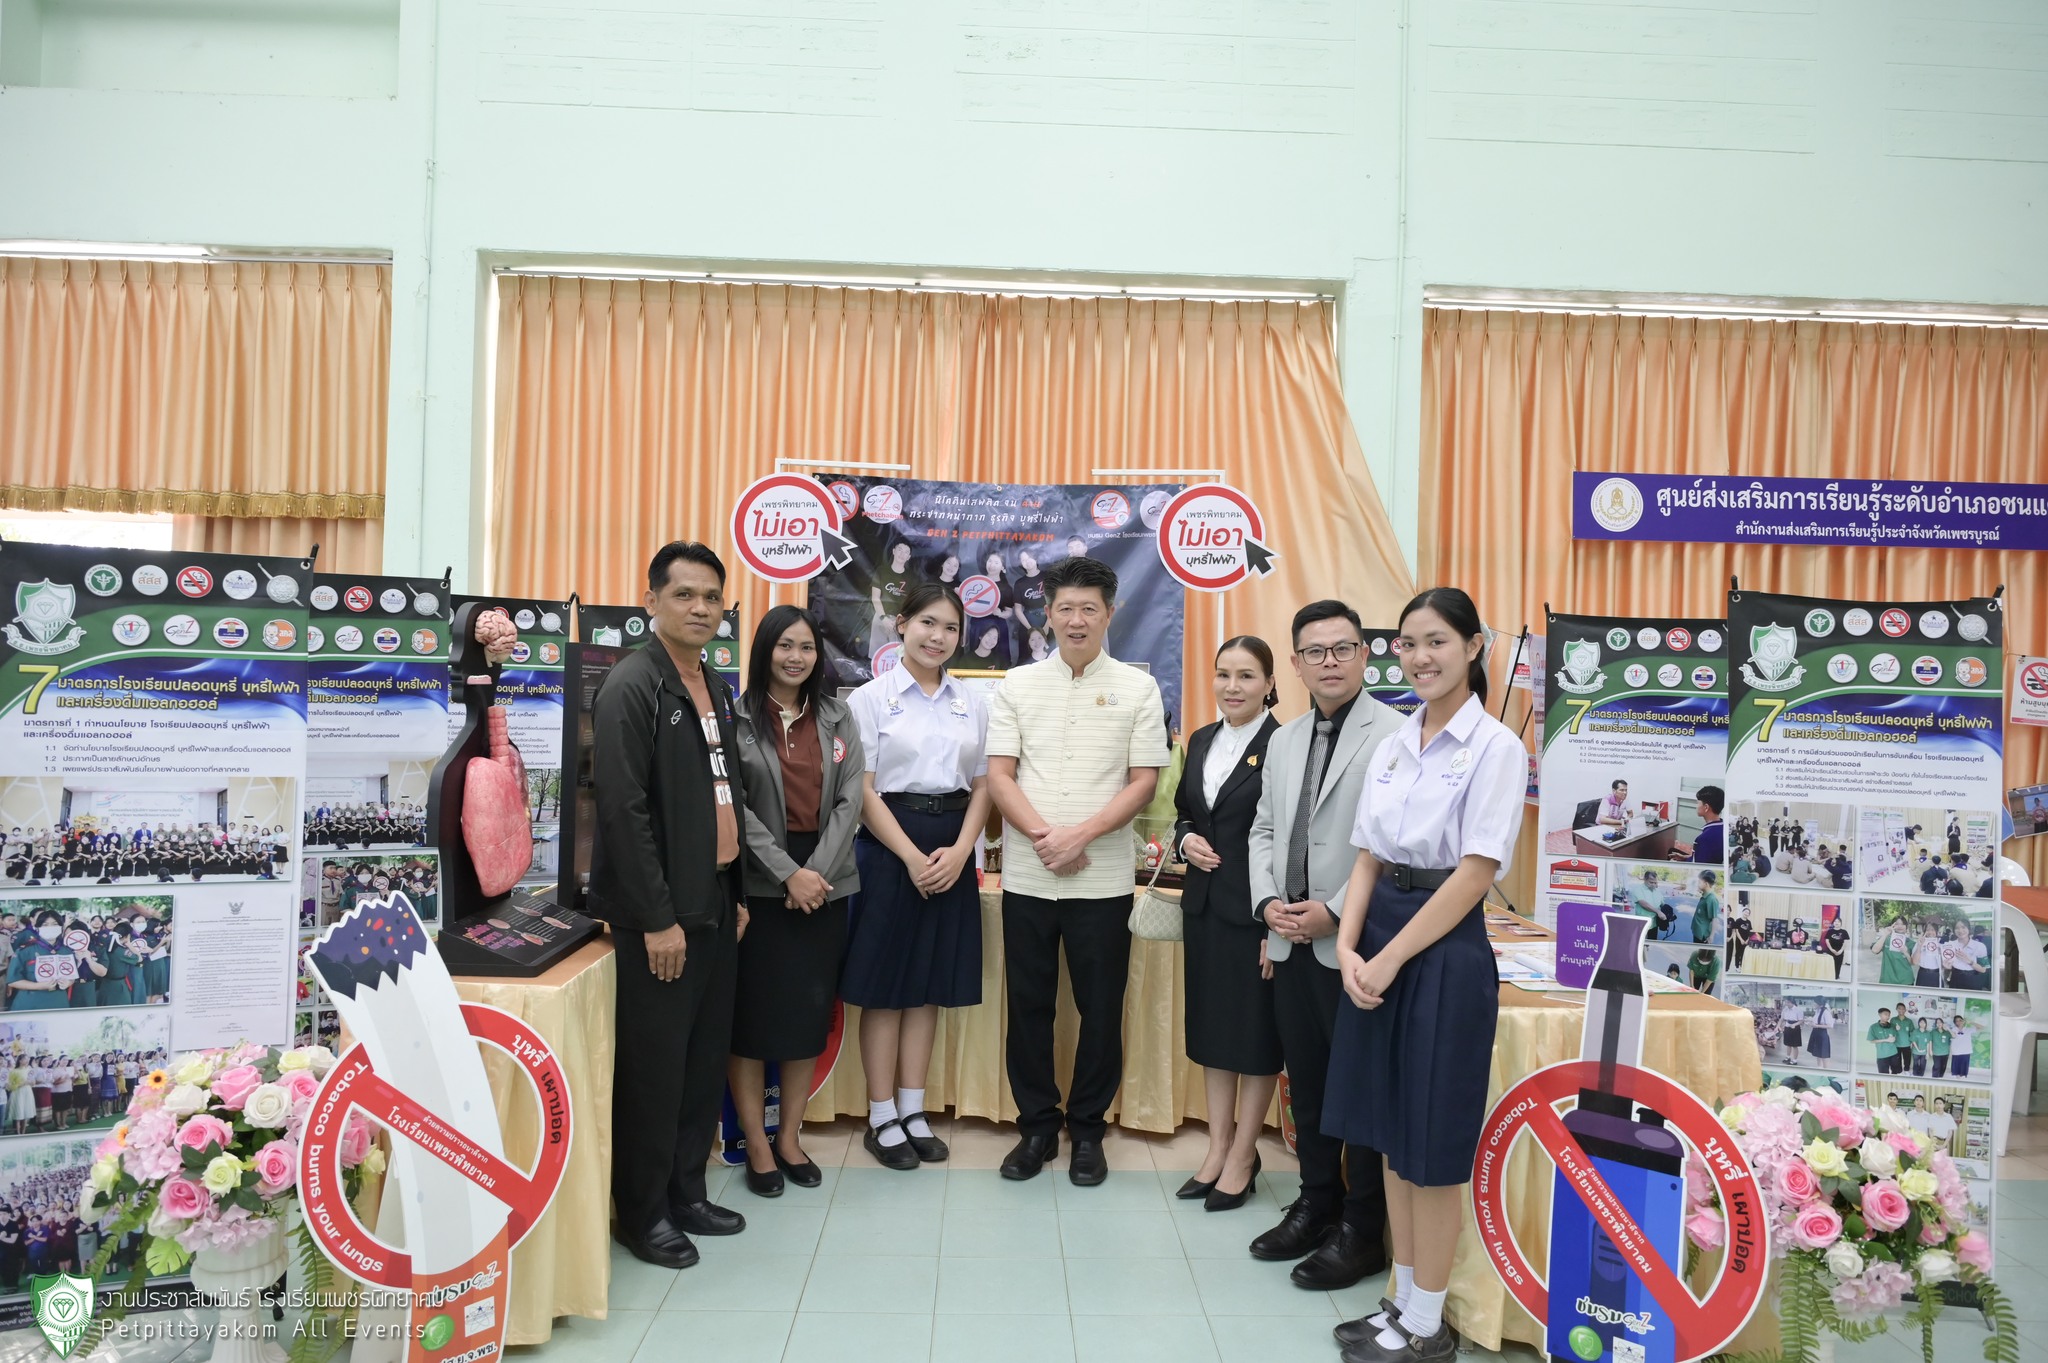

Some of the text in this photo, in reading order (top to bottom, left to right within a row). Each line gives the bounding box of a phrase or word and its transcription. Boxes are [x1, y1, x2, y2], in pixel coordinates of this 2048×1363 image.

[761, 500, 818, 509] เพชรพิทยาคม
[1656, 479, 2048, 521] ศูนย์ส่งเสริมการเรียนรู้ระดับอำเภอชนแ
[753, 509, 819, 537] ไม่เอา
[862, 511, 904, 520] Phetchabun
[1020, 511, 1064, 527] บุหรี่ไฟฟ้า
[1186, 510, 1242, 519] เพชรพิทยาคม
[1178, 519, 1243, 547] ไม่เอา
[1735, 521, 1999, 544] สำนักงานส่งเสริมการเรียนรู้ประจำจังหวัดเพชรบูรณ์
[761, 542, 812, 558] บุหรี่ไฟฟ้า
[1186, 552, 1236, 566] บุหรี่ไฟฟ้า
[18, 664, 60, 714] 7
[57, 676, 300, 696] มาตรการโรงเรียนปลอดบุหรี่ บุหรี่ไฟฟ้า
[396, 678, 442, 692] บุหรี่ไฟฟ้า
[527, 682, 564, 695] บุหรี่ไฟฟ้า
[56, 692, 219, 710] และเครื่องดื่มแอลกอฮอล์
[24, 718, 72, 727] มาตรการที่
[84, 719, 147, 728] กำหนดนโยบาย
[150, 720, 228, 730] โรงเรียนปลอดบุหรี่
[231, 720, 270, 731] บุหรี่ไฟฟ้า
[1565, 698, 1592, 735] 7
[1589, 709, 1708, 726] มาตรการโรงเรียนปลอดบุหรี่
[1753, 698, 1786, 743] 7
[1783, 710, 1992, 731] มาตรการโรงเรียนปลอดบุหรี่ บุหรี่ไฟฟ้า
[23, 729, 132, 739] และเครื่องดื่มแอลกอฮอล์
[1589, 721, 1695, 737] และเครื่องดื่มแอลกอฮอล์
[1783, 724, 1917, 743] และเครื่องดื่มแอลกอฮอล์
[1924, 754, 1984, 764] โรงเรียนปลอดบุหรี่
[1577, 924, 1597, 932] เกมส์
[1560, 953, 1598, 968] ต้านบุหรี่ไ
[512, 1034, 564, 1144] บุหรี่ เผาปอด
[387, 1105, 496, 1188] โรงเรียนเพชรพิทยาคม
[309, 1061, 384, 1272] Tobacco burns your lungs
[1479, 1097, 1538, 1286] Tobacco burns your lungs
[1559, 1146, 1653, 1273] โรงเรียนเพชรพิทยาคม
[1704, 1137, 1754, 1273] บุหรี่ เผาปอด
